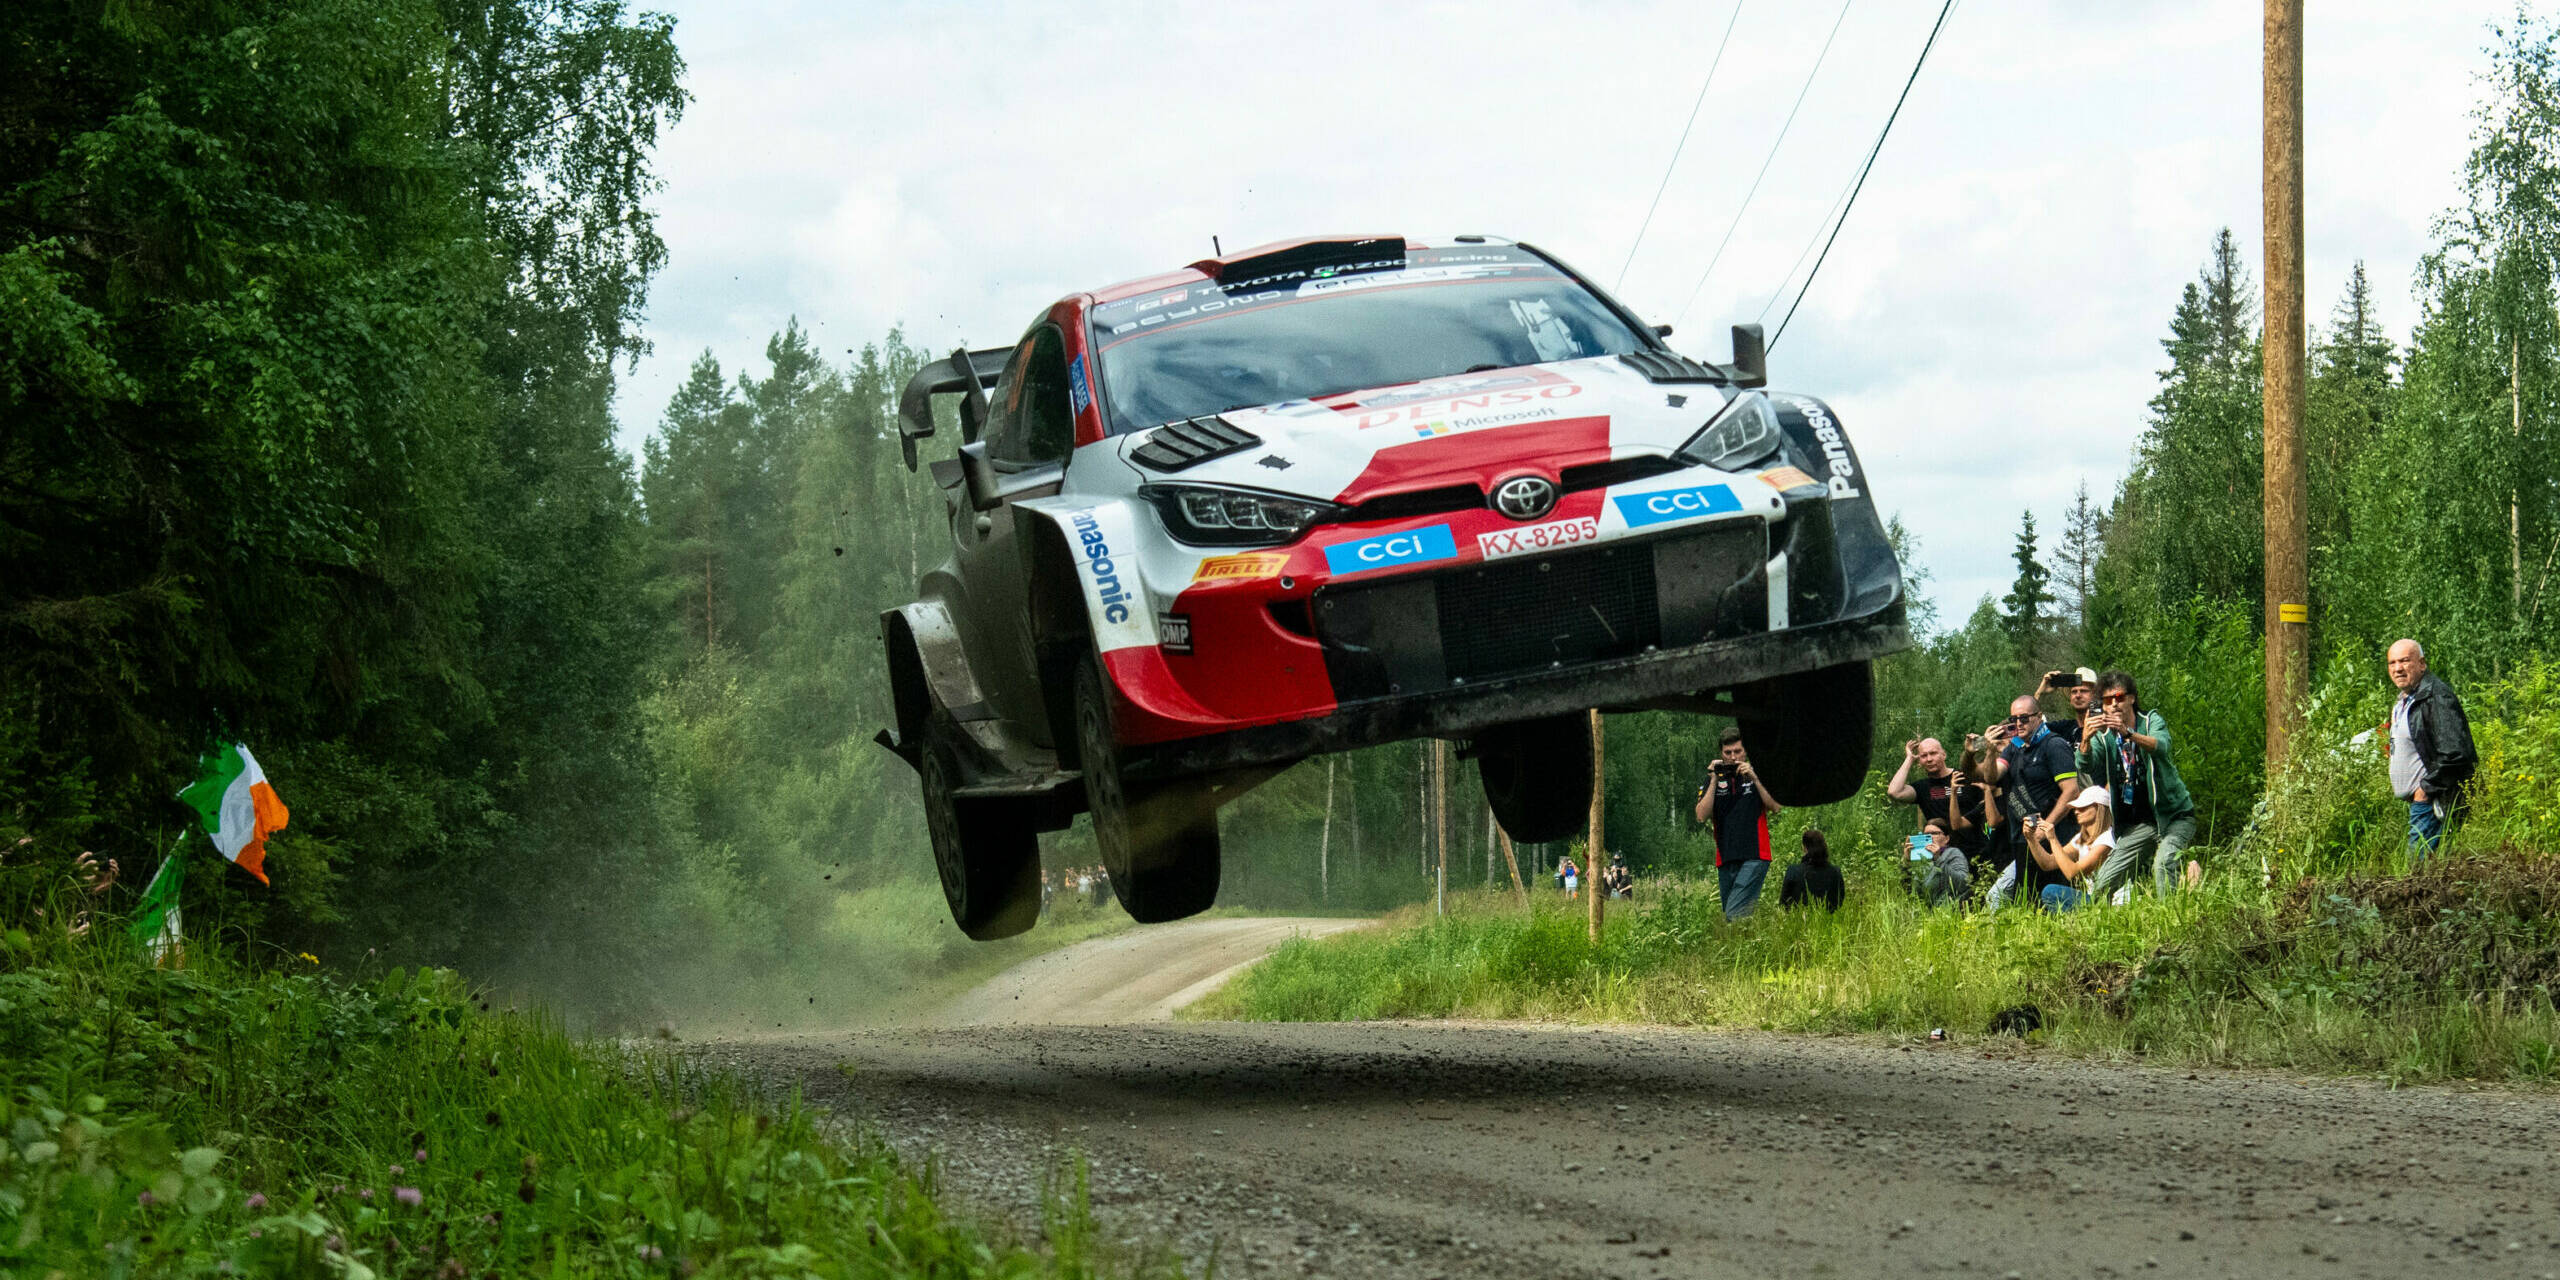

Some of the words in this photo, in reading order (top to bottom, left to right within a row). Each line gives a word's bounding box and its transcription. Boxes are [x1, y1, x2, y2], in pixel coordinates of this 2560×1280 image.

[1196, 271, 1306, 296] TOYOTA
[1358, 384, 1582, 430] DENSO
[1453, 405, 1559, 429] Microsoft
[1481, 519, 1597, 556] KX-8295
[1200, 556, 1281, 577] PIRELLI
[1160, 623, 1189, 644] OMP
